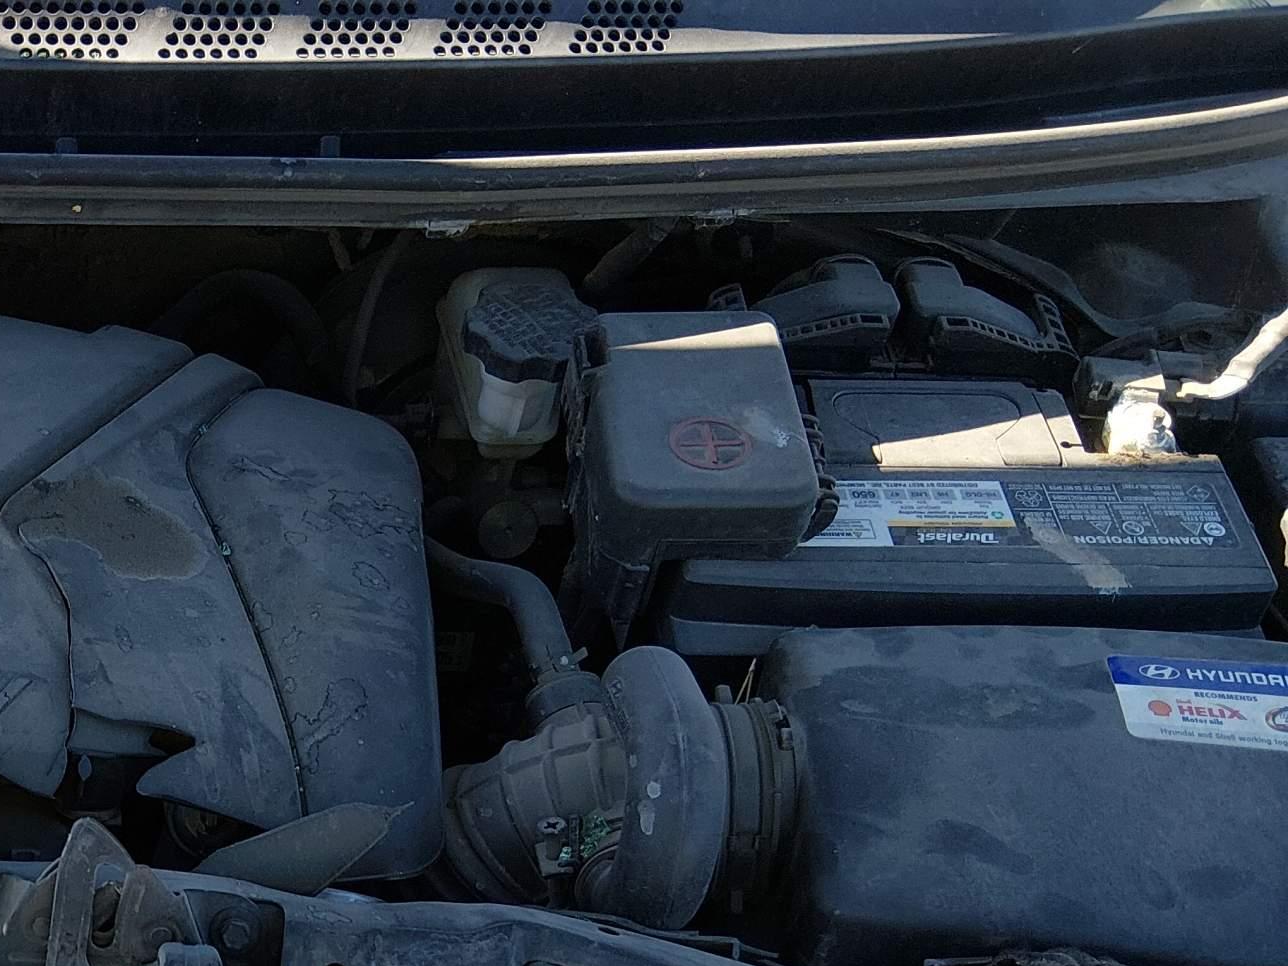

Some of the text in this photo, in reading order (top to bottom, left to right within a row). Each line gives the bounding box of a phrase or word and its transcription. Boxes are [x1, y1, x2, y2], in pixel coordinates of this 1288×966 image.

[851, 490, 876, 499] 650
[917, 532, 999, 544] Duralast
[1073, 535, 1202, 545] DANGER/POISON
[1193, 691, 1258, 702] RECOMMENDS
[1177, 703, 1247, 720] HELIX
[1182, 716, 1208, 725] Motor
[1159, 728, 1195, 738] Hyundai
[1215, 732, 1236, 741] Shell
[1238, 734, 1272, 746] working
